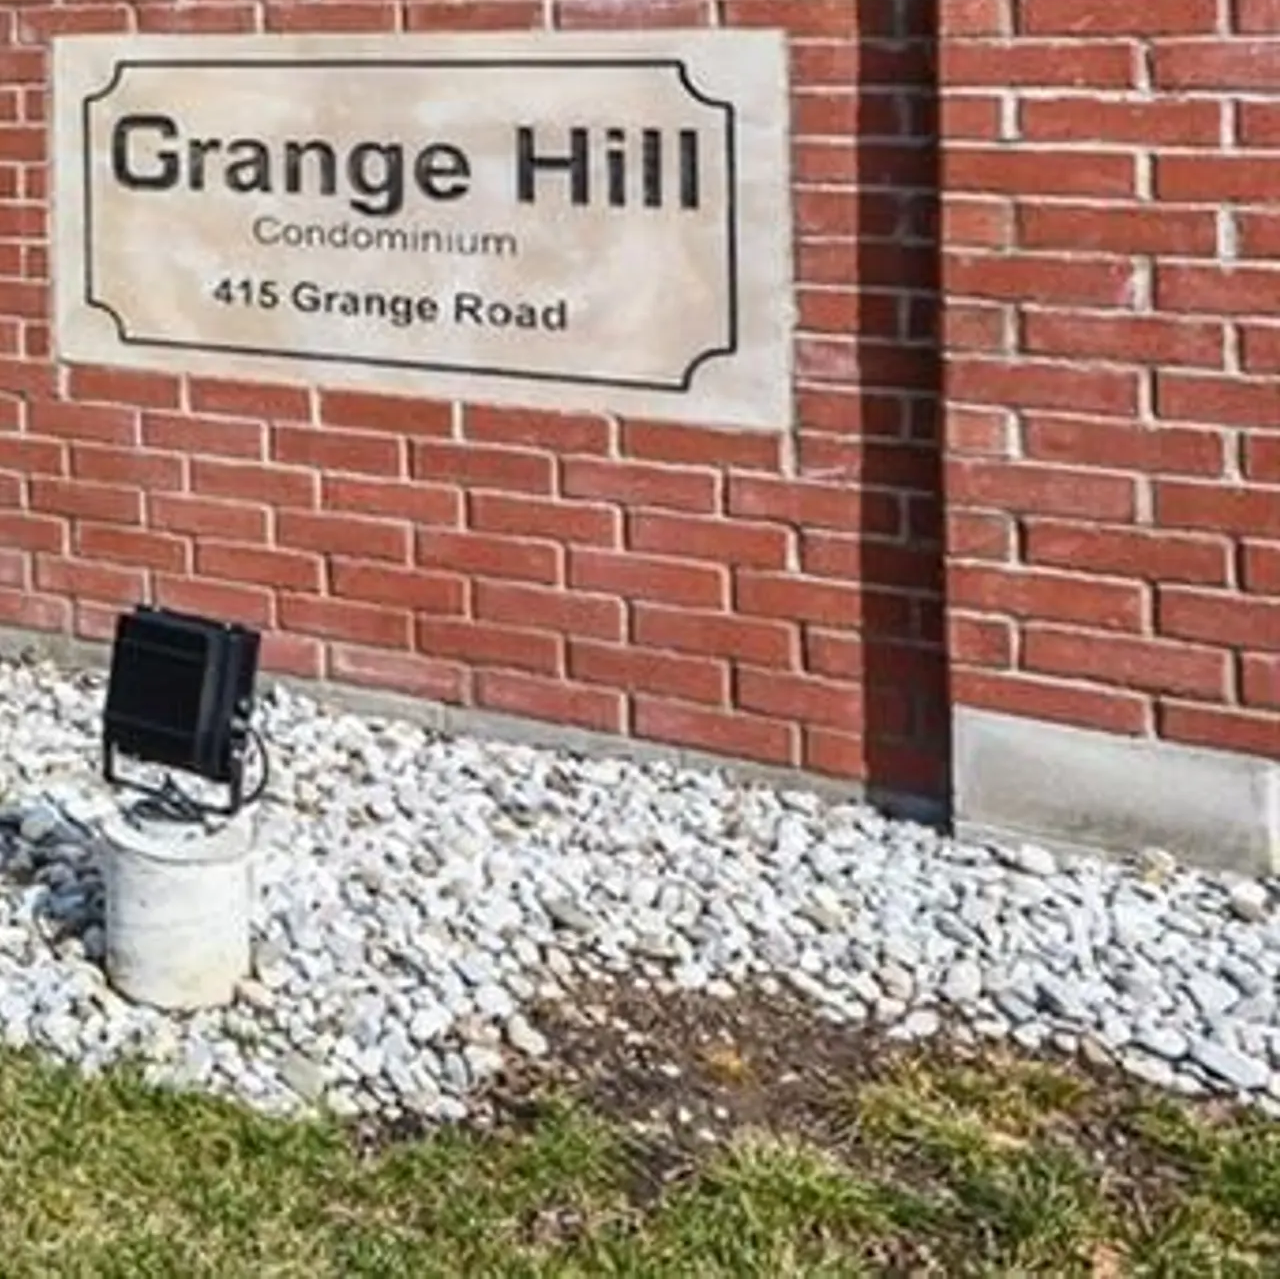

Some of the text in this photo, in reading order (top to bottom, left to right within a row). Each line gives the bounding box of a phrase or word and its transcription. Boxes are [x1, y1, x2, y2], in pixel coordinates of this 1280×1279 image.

[112, 114, 700, 217] Grange Hill
[253, 216, 519, 258] Condominium
[212, 280, 568, 332] 415 Grange Road
